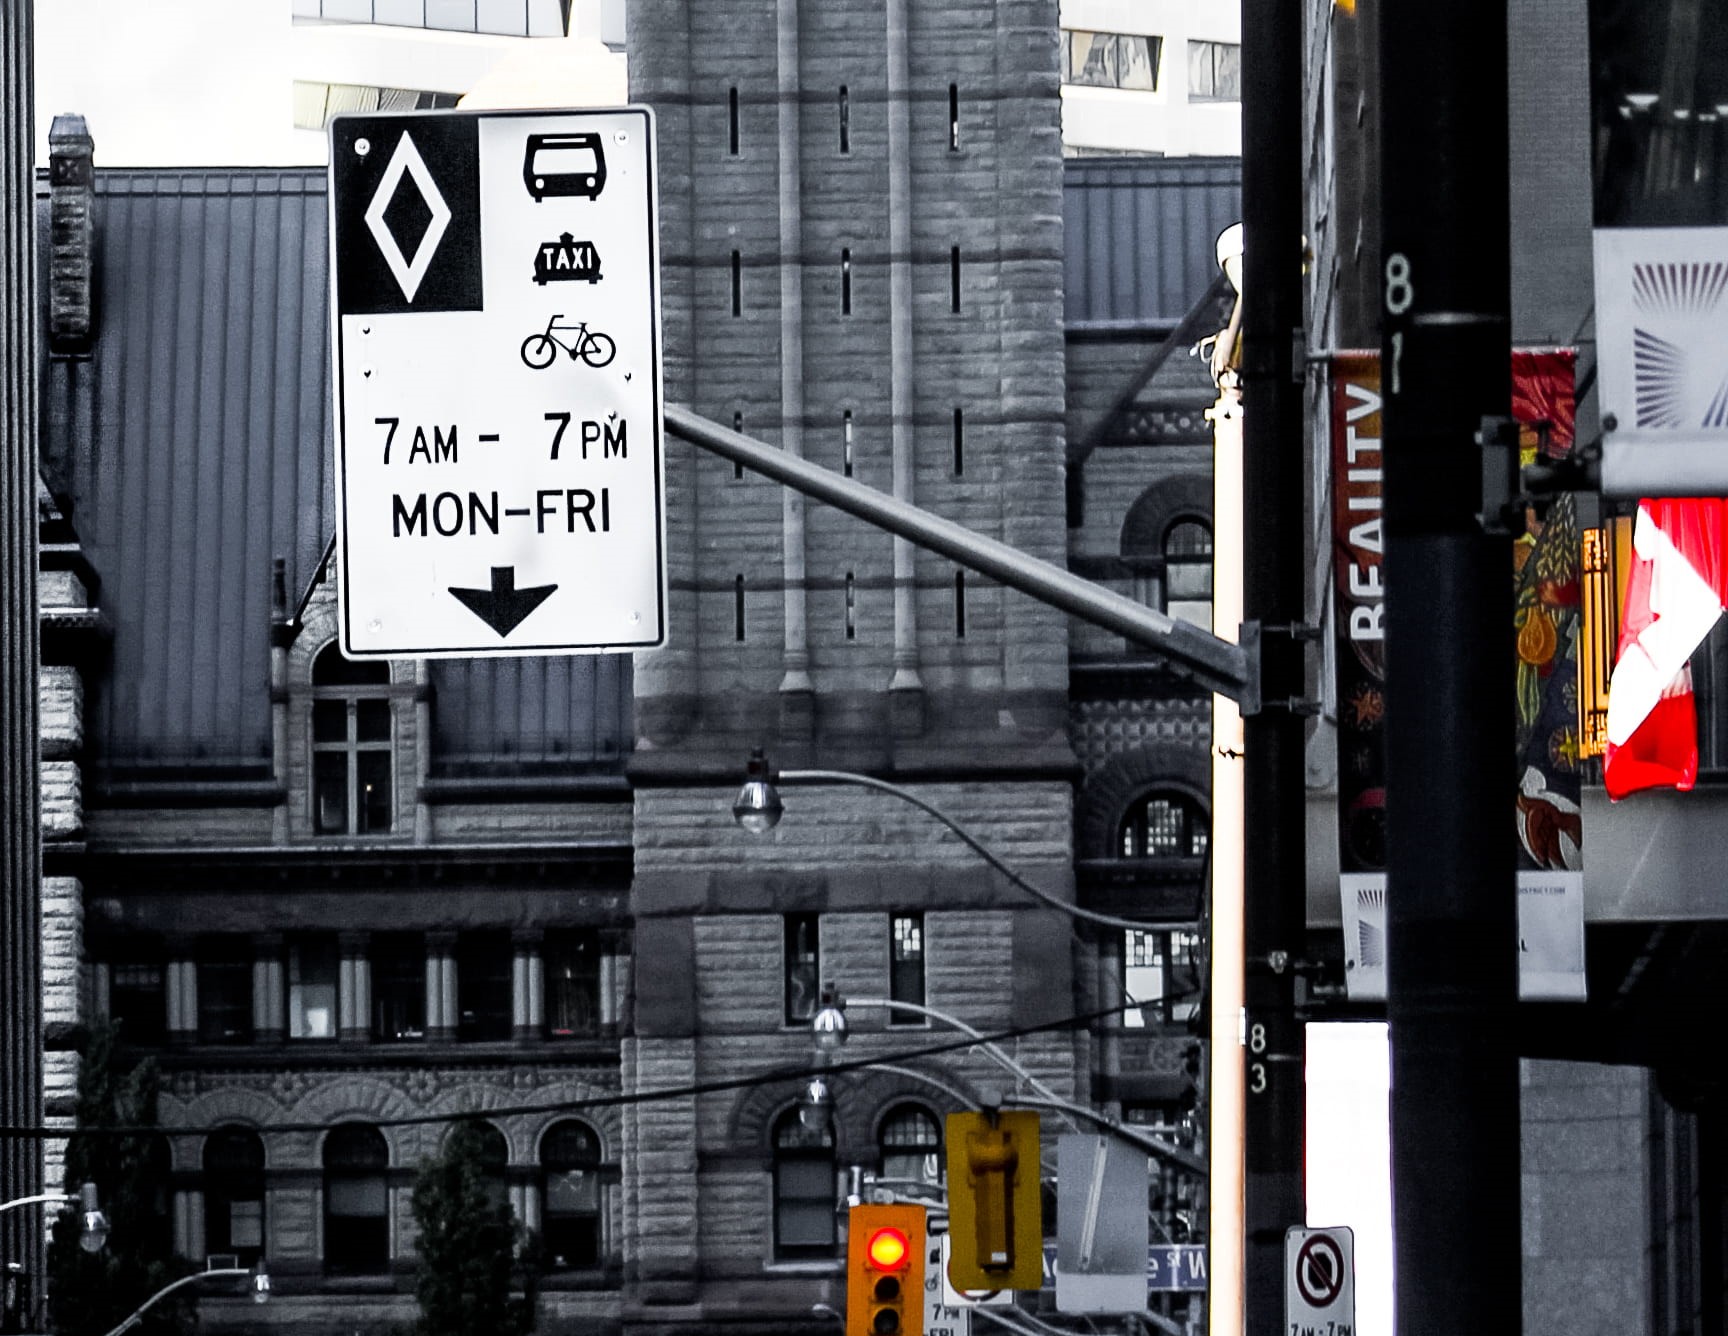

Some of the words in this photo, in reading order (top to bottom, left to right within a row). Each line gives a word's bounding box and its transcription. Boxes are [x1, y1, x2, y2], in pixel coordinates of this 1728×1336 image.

[543, 247, 593, 271] TAXI
[391, 487, 611, 538] MON-FRI
[1188, 1250, 1207, 1280] W
